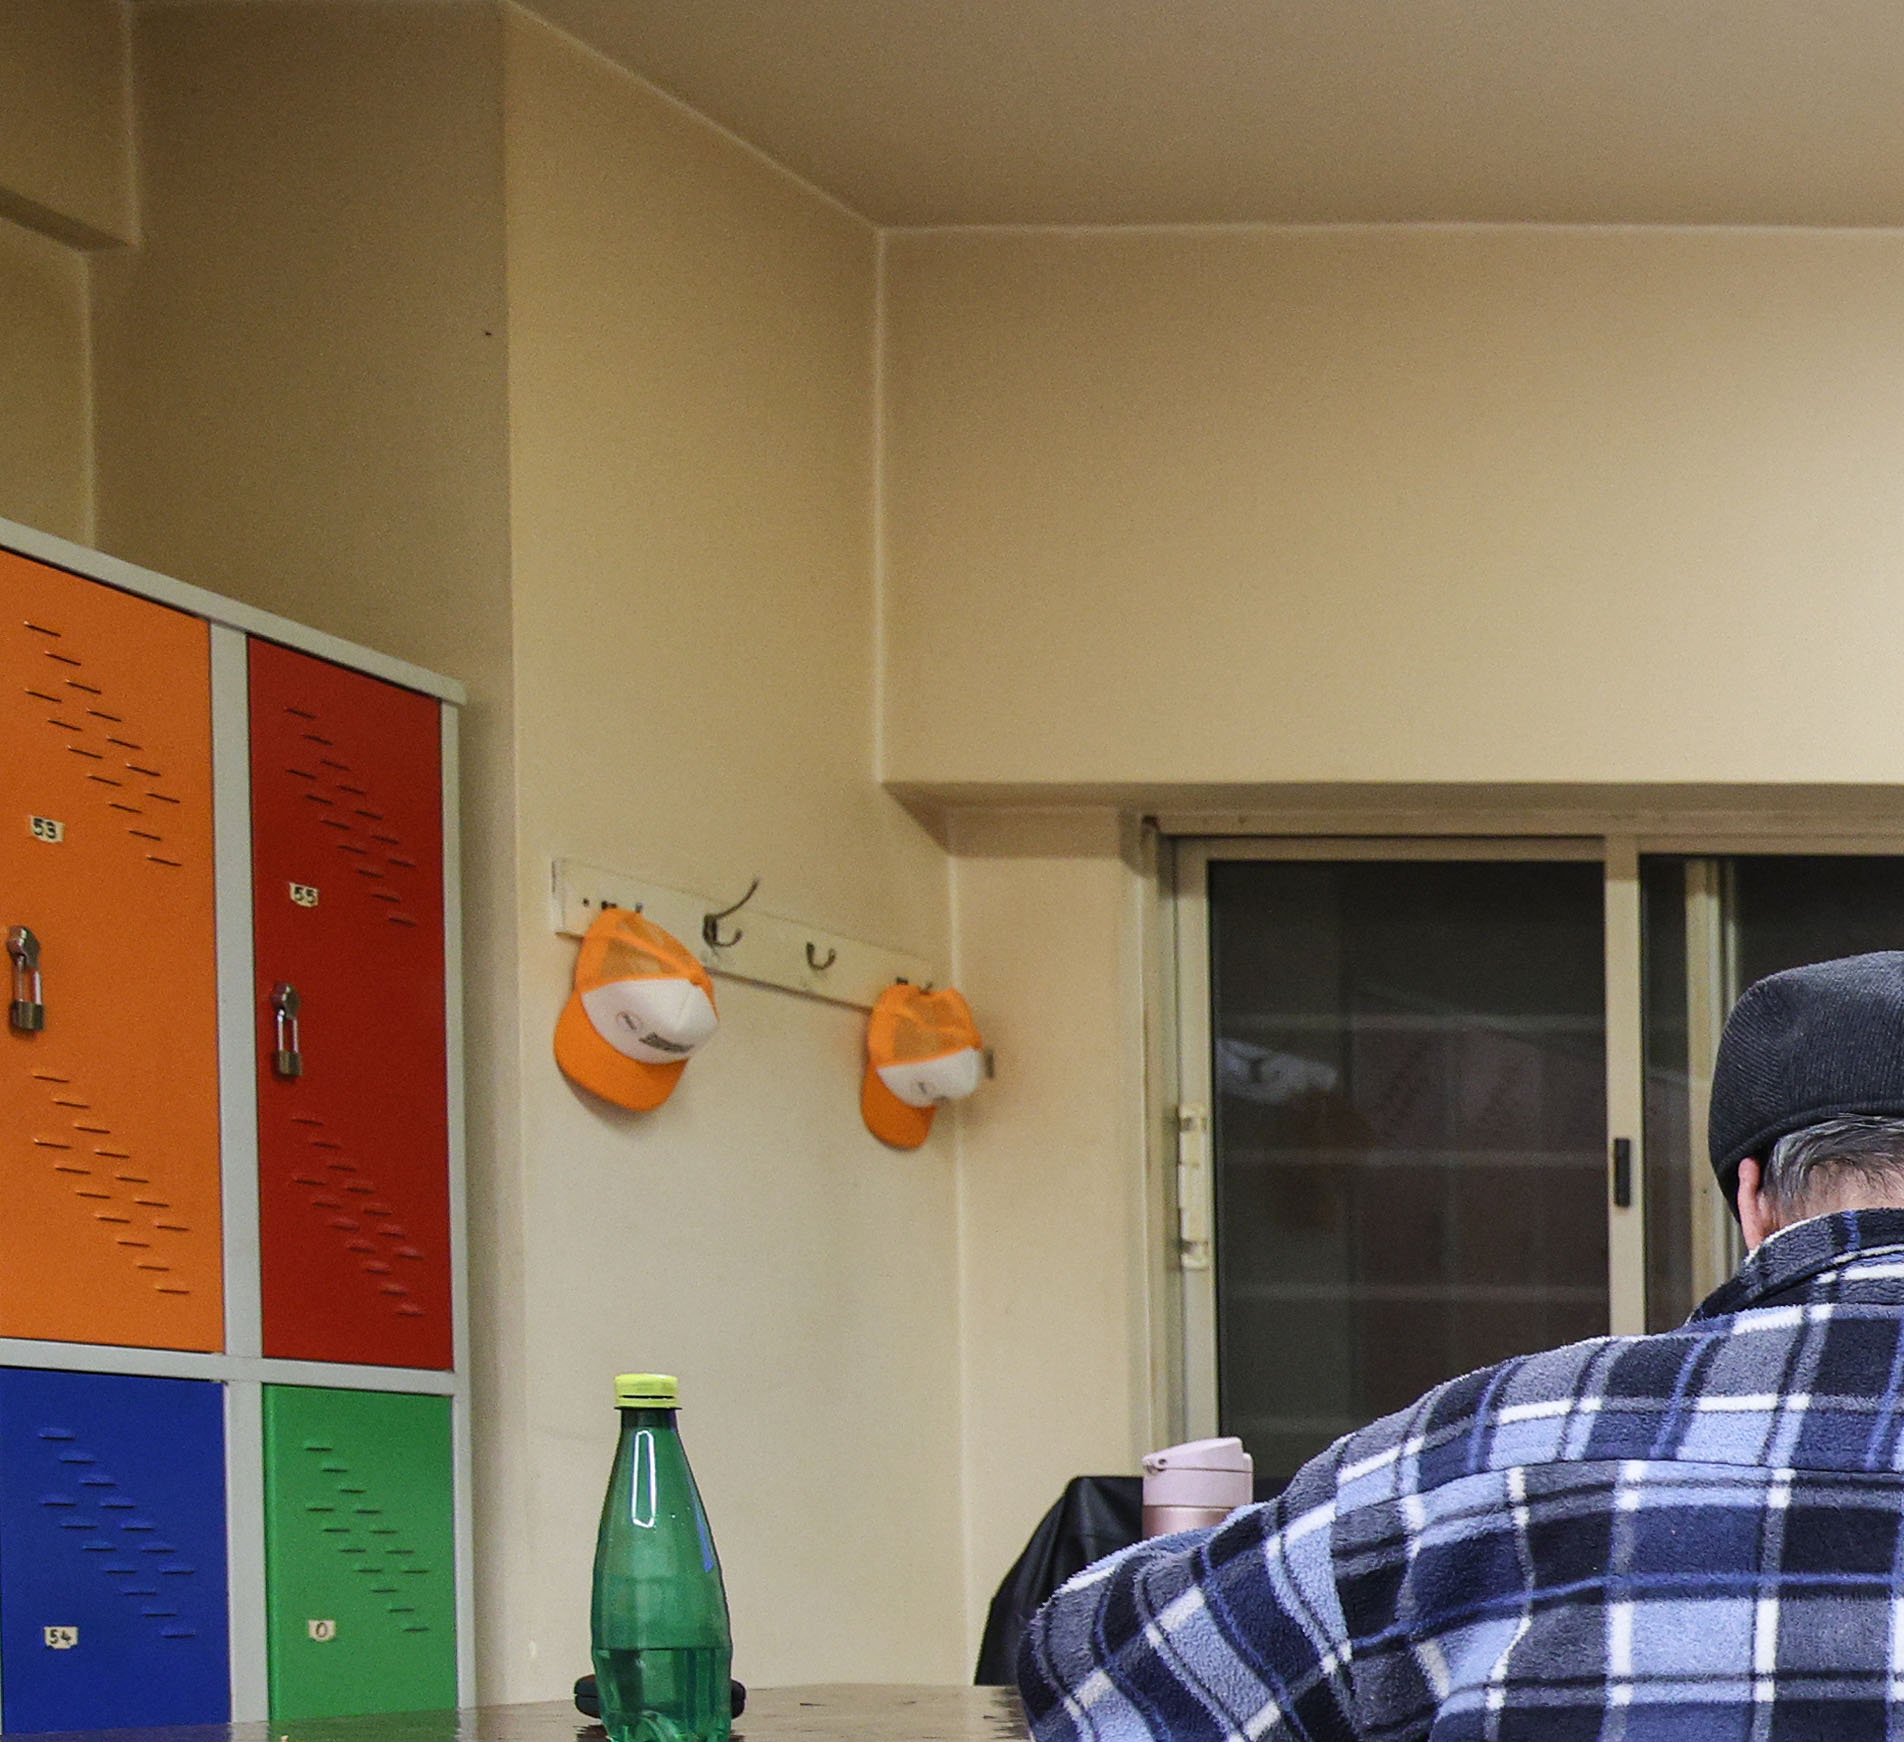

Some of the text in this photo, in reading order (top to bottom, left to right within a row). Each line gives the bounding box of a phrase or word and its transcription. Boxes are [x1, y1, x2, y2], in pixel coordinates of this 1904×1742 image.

[33, 817, 56, 839] 53
[294, 886, 315, 904] 55
[50, 1629, 72, 1646] 54
